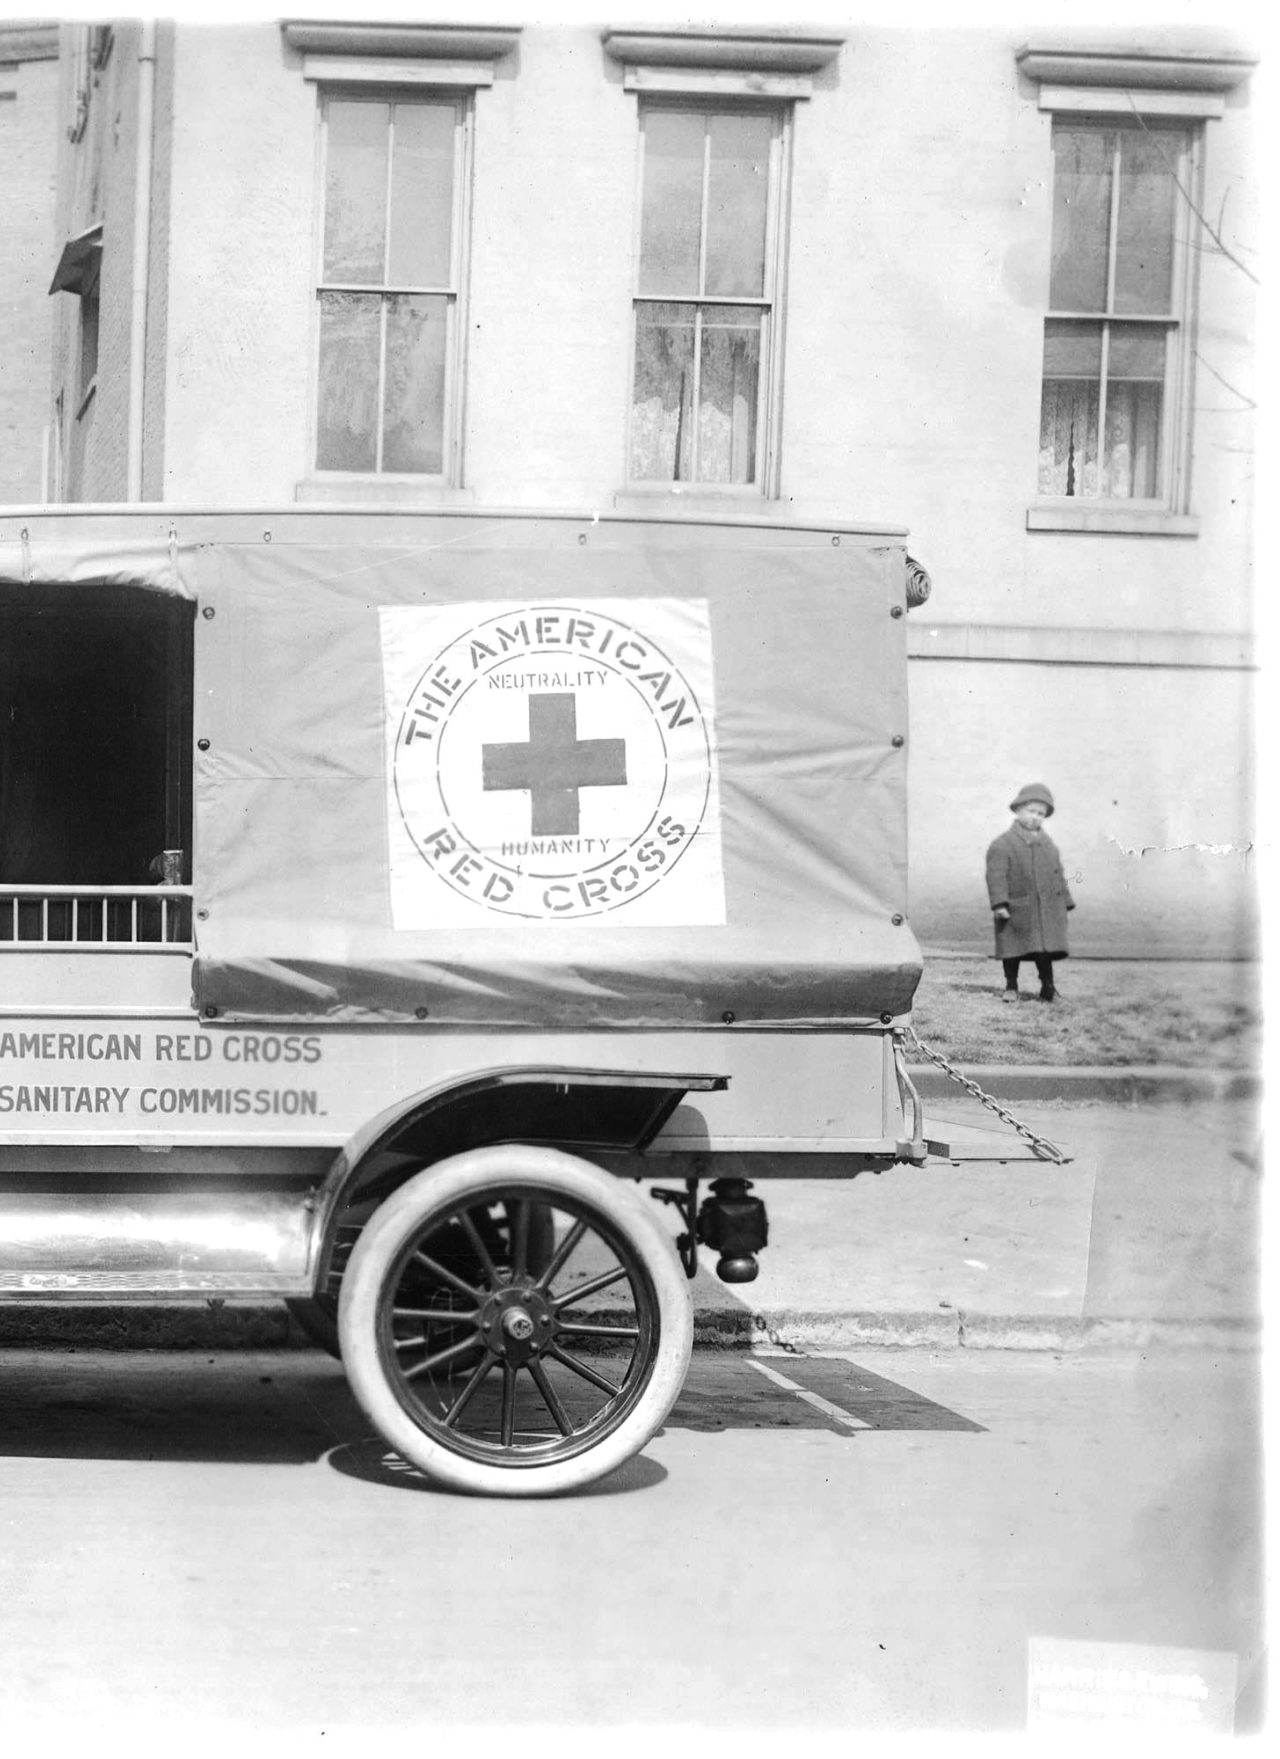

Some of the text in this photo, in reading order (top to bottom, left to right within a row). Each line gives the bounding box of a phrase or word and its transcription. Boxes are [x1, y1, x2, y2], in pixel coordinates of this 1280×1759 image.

[405, 617, 694, 745] THE AMERICAN
[489, 671, 609, 690] NEUTRALITY
[502, 838, 611, 857] HUMANITY
[424, 816, 686, 912] RED CROSS
[0, 1032, 322, 1063] AMERICAN RED CROSS
